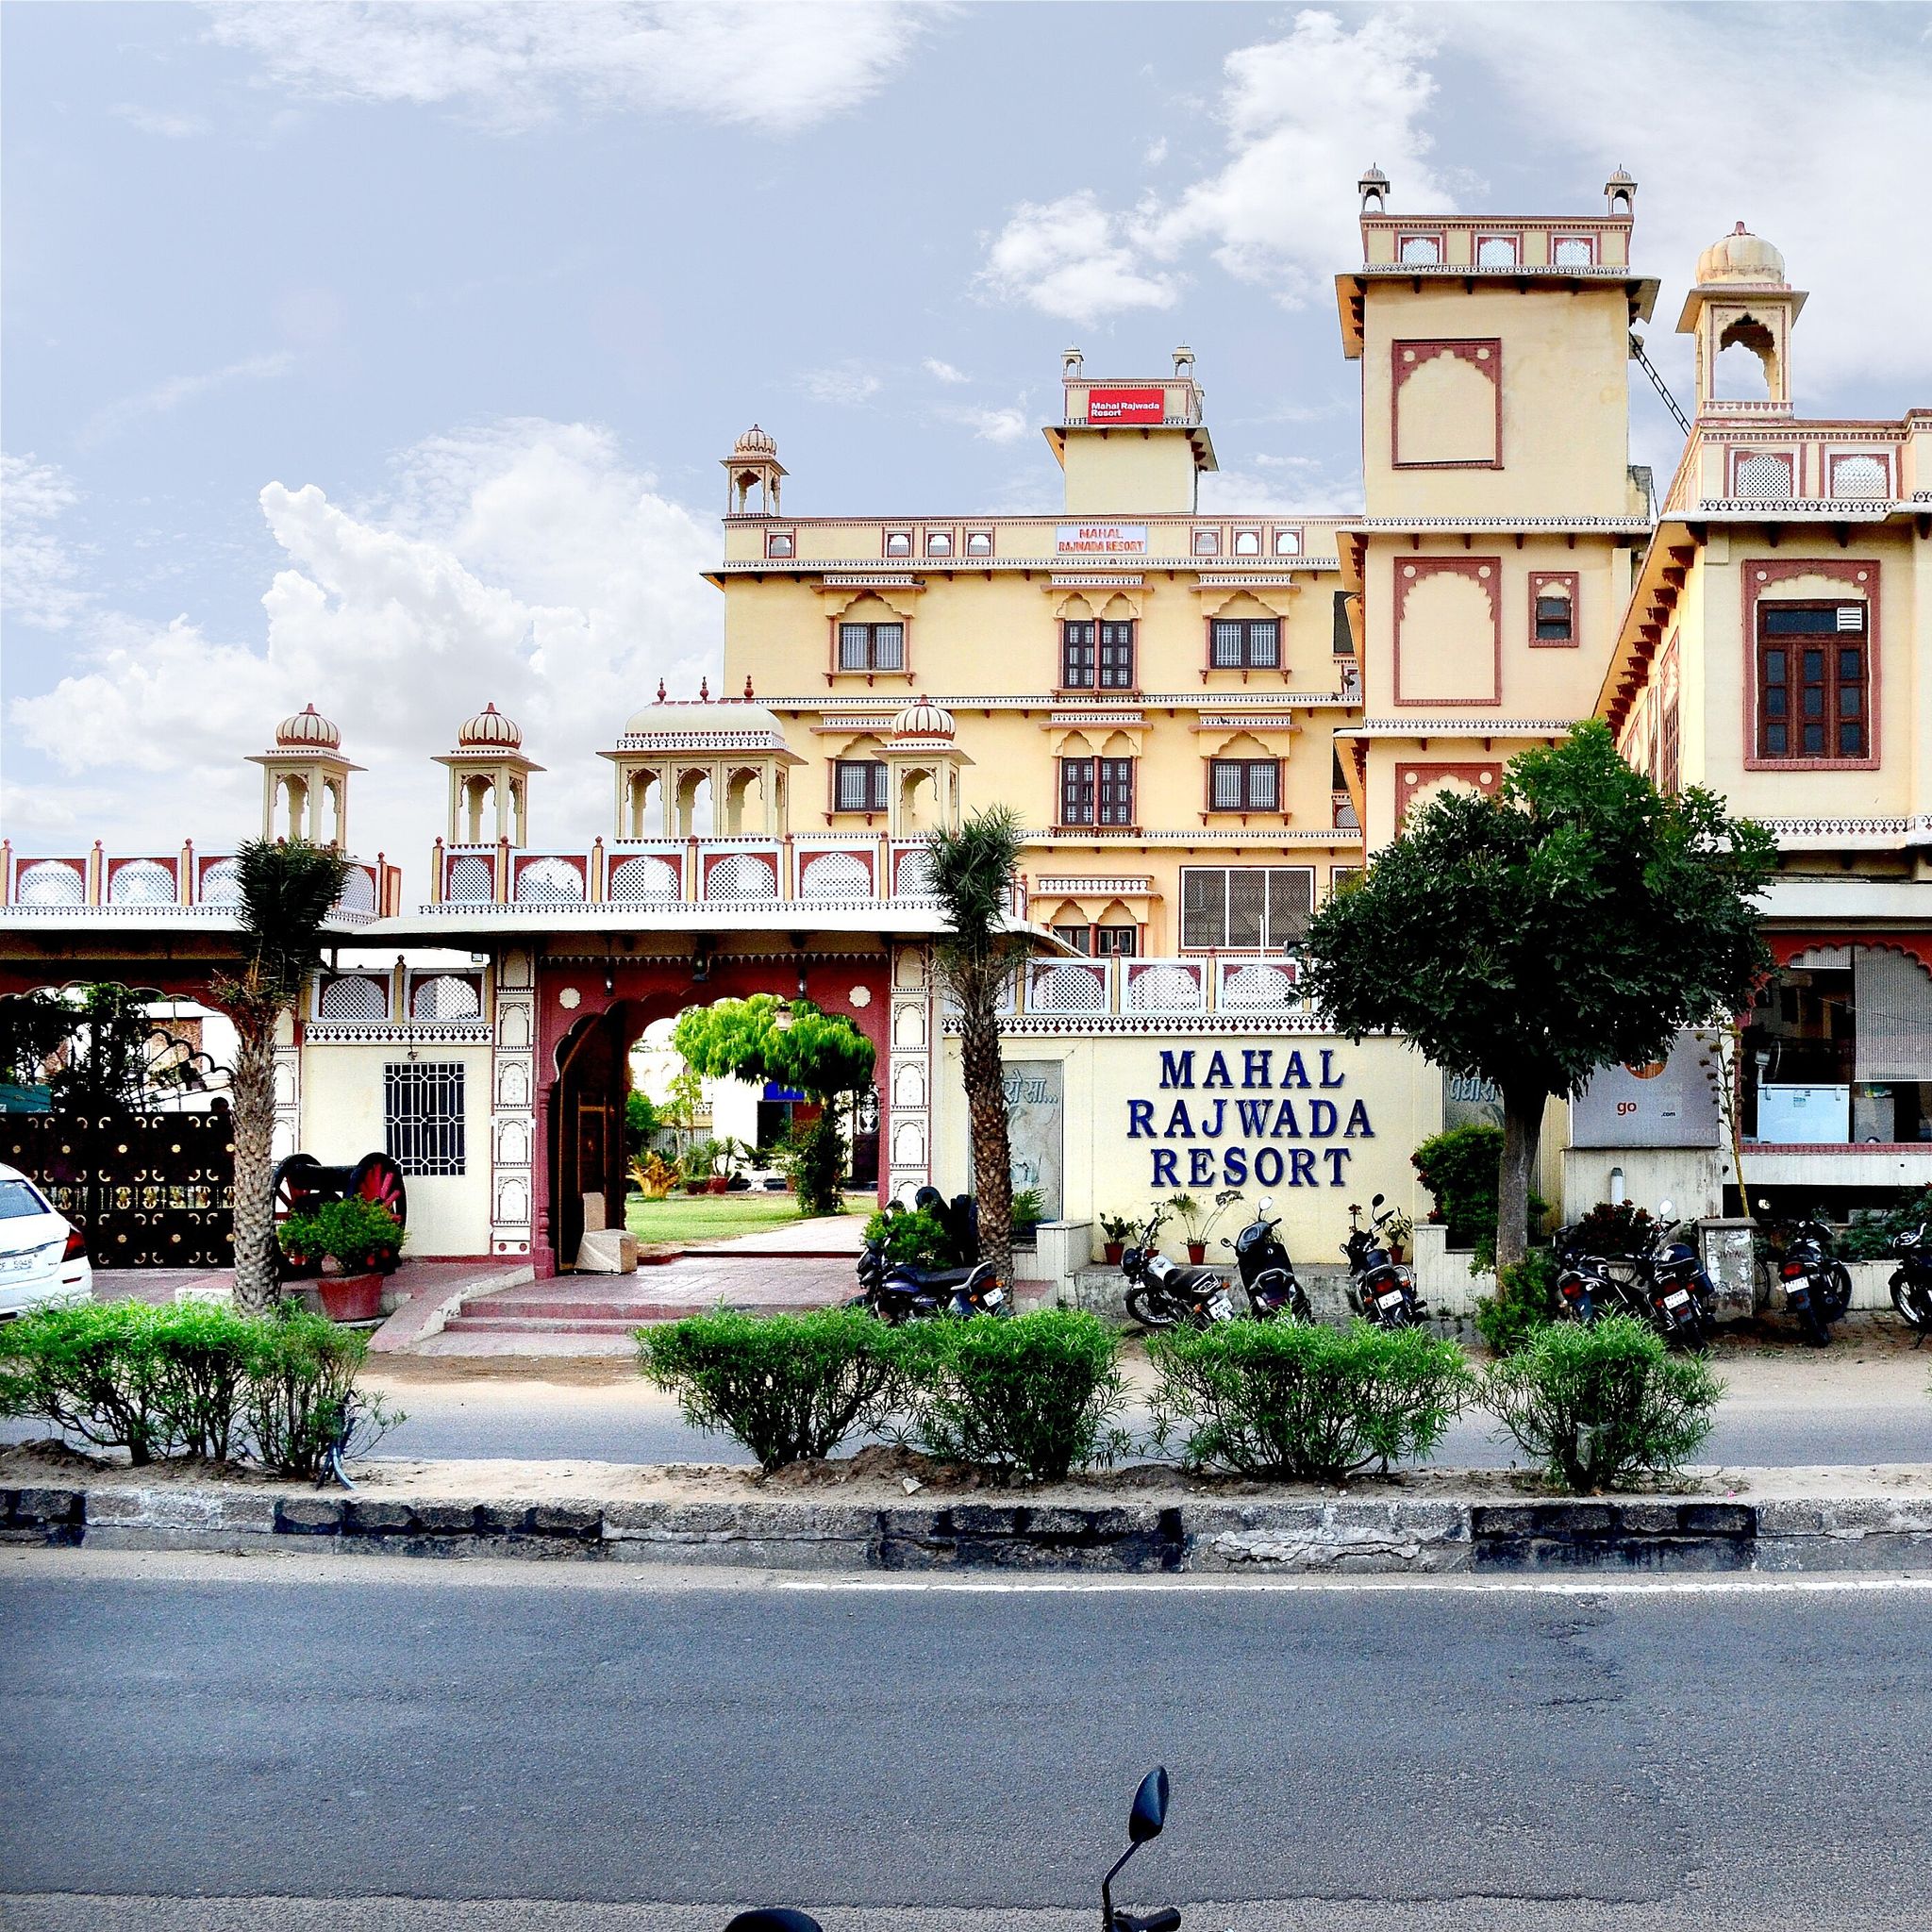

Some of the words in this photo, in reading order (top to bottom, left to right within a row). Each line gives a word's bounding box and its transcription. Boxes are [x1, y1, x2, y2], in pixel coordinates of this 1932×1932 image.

[1091, 402, 1120, 410] Mahal
[1121, 402, 1159, 411] Rajwada
[1079, 528, 1124, 539] MAHAL
[1058, 541, 1105, 552] RAJWADA
[1106, 541, 1144, 552] RESORT
[1159, 1049, 1345, 1089] MAHAL
[1617, 1102, 1637, 1116] go
[1126, 1099, 1375, 1139] RAJWADA
[1150, 1146, 1352, 1187] RESORT
